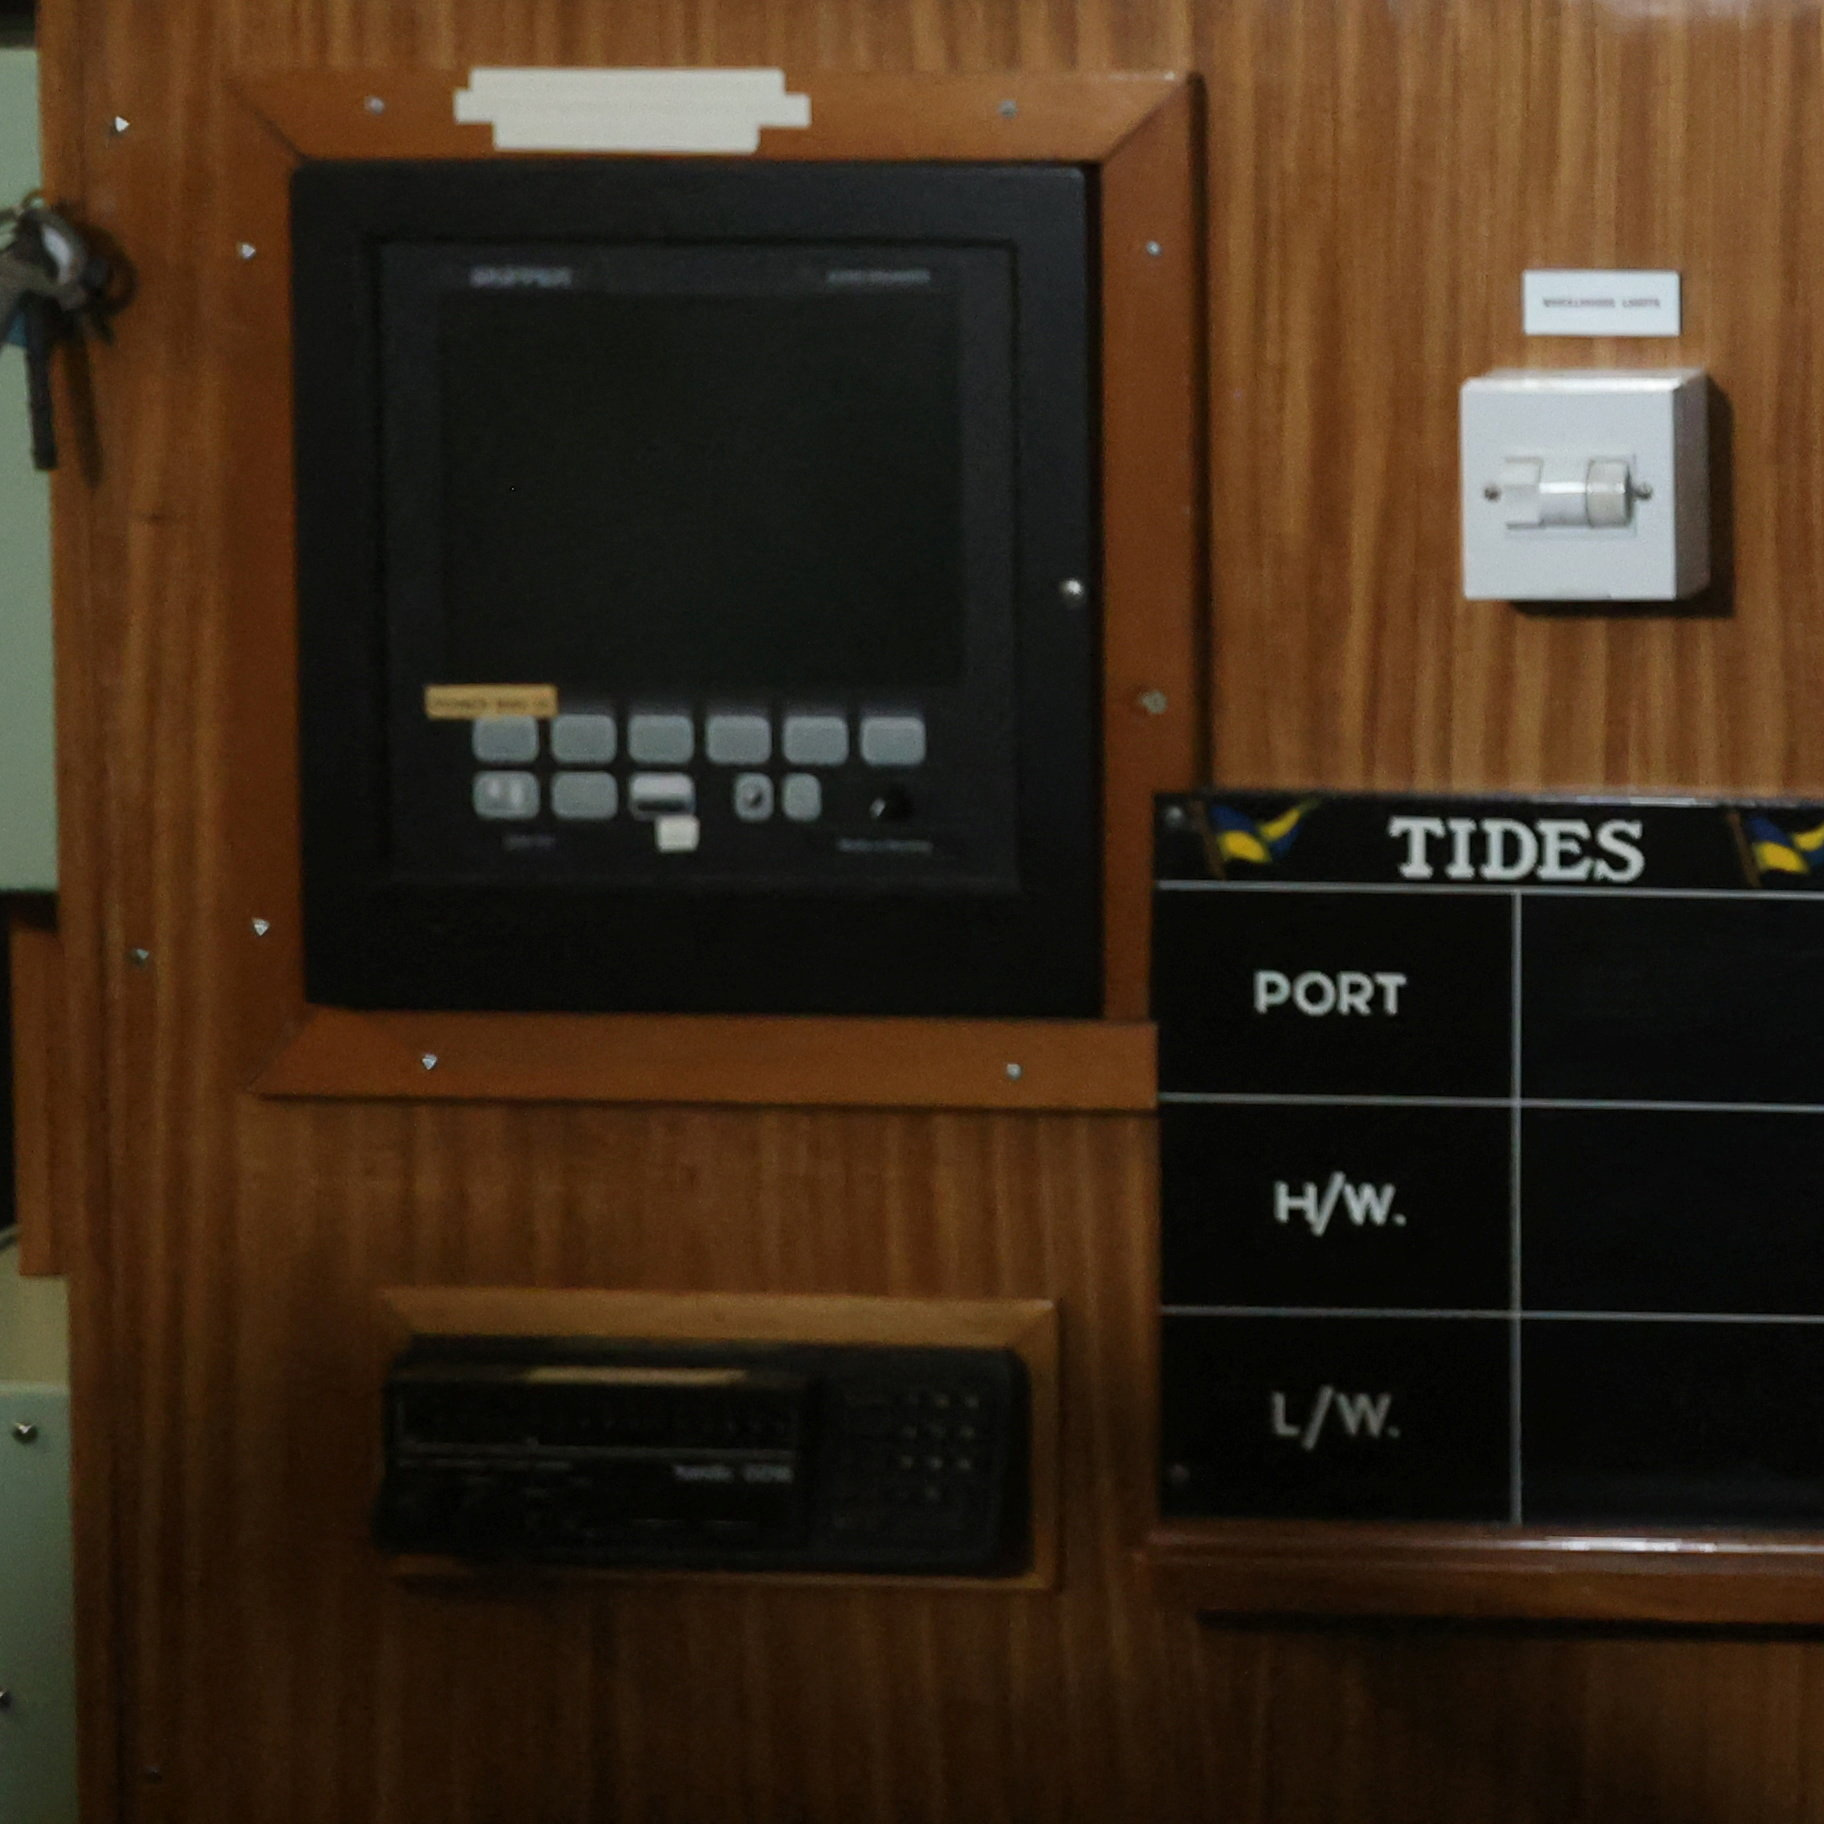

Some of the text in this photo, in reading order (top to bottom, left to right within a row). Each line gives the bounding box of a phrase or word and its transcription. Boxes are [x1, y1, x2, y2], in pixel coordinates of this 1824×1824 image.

[1389, 816, 1645, 882] TIDES
[1254, 969, 1408, 1016] PORT
[1274, 1171, 1407, 1237] H/W.
[1271, 1385, 1400, 1451] L/W.
